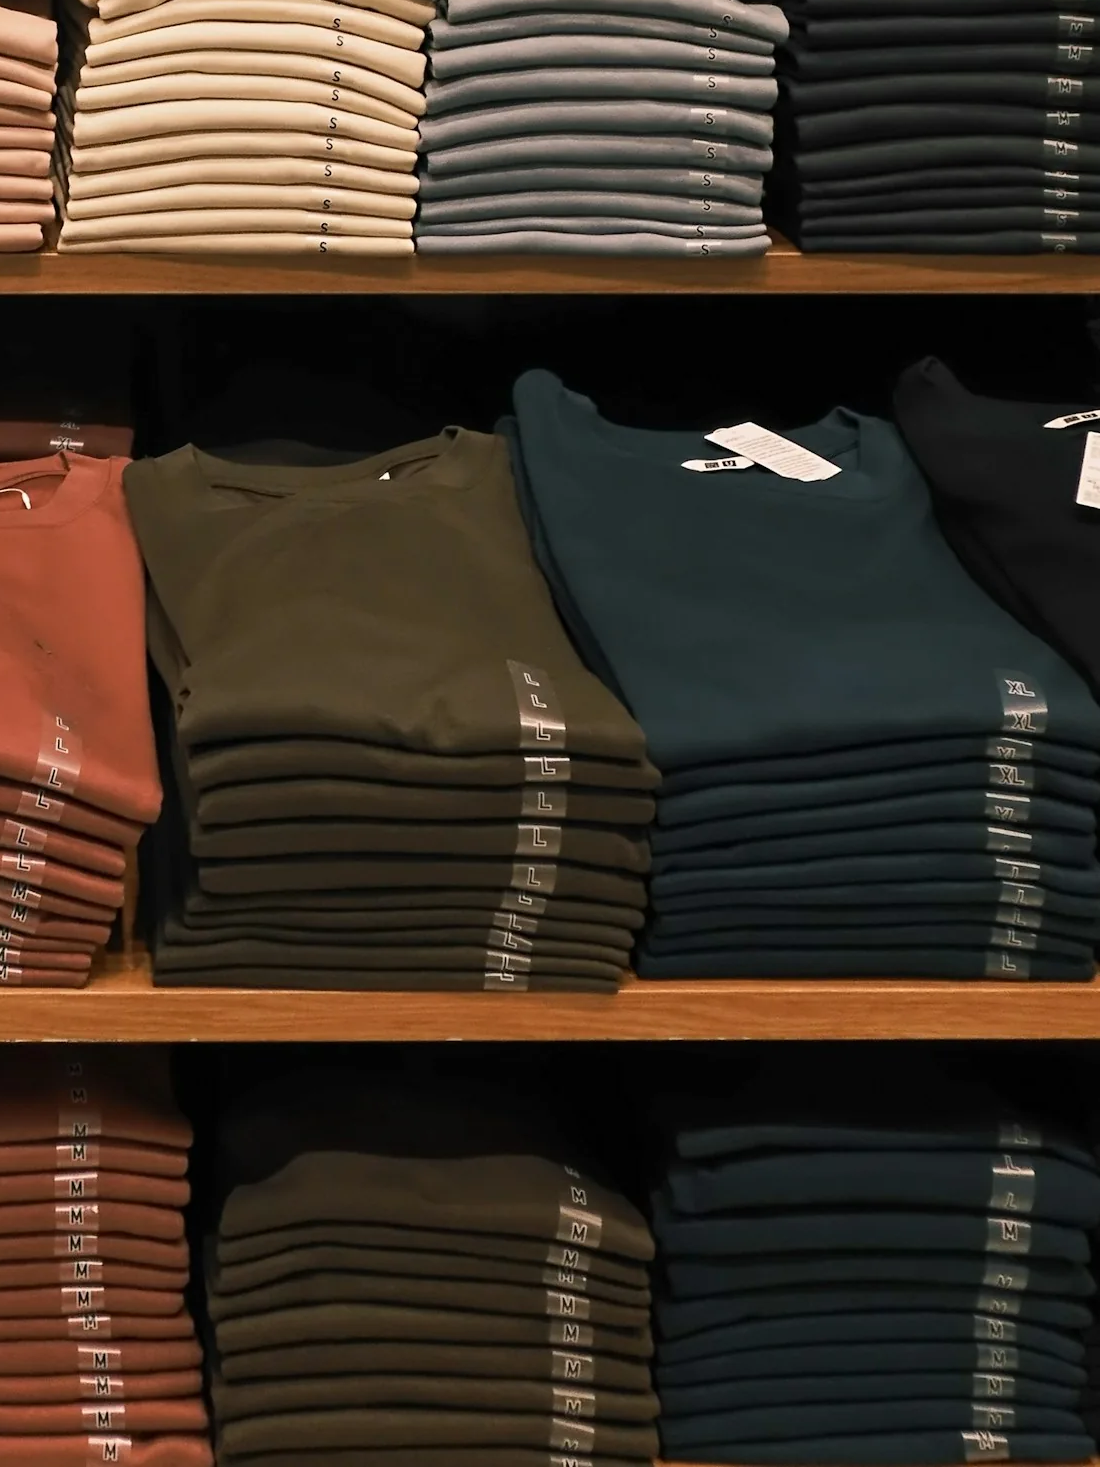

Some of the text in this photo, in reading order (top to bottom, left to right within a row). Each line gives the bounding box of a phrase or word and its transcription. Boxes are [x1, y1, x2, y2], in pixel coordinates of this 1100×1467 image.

[708, 48, 716, 60] S
[1058, 80, 1071, 94] M
[329, 117, 338, 129] S
[706, 112, 714, 125] S
[706, 146, 716, 159] S
[324, 164, 332, 176] S
[704, 174, 712, 187] S
[323, 198, 331, 209] S
[320, 241, 327, 253] S
[523, 672, 540, 687] L
[1004, 679, 1035, 697] XL
[530, 694, 547, 709] L
[56, 716, 69, 730] L
[1011, 712, 1036, 731] XL
[536, 721, 551, 741] L
[55, 737, 69, 754] L
[541, 756, 556, 775] L
[47, 767, 61, 788] L
[1000, 765, 1025, 786] XL
[35, 790, 50, 810] L
[537, 791, 552, 811] L
[15, 827, 30, 847] L
[533, 826, 547, 847] L
[16, 853, 31, 872] L
[526, 866, 540, 886] L
[11, 883, 28, 901] M
[11, 904, 28, 922] M
[508, 913, 522, 931] L
[503, 932, 517, 949] L
[1008, 930, 1022, 946] L
[1002, 953, 1016, 972] L
[70, 1180, 84, 1198] M
[571, 1186, 587, 1206] M
[69, 1207, 84, 1225] M
[570, 1222, 587, 1243] M
[68, 1236, 83, 1252] M
[562, 1249, 579, 1268] M
[75, 1264, 89, 1279] M
[77, 1291, 91, 1307] M
[559, 1294, 576, 1315] M
[563, 1323, 579, 1343] M
[93, 1352, 109, 1369] M
[564, 1359, 581, 1378] M
[96, 1377, 110, 1395] M
[96, 1411, 111, 1429] M
[103, 1443, 118, 1462] M
